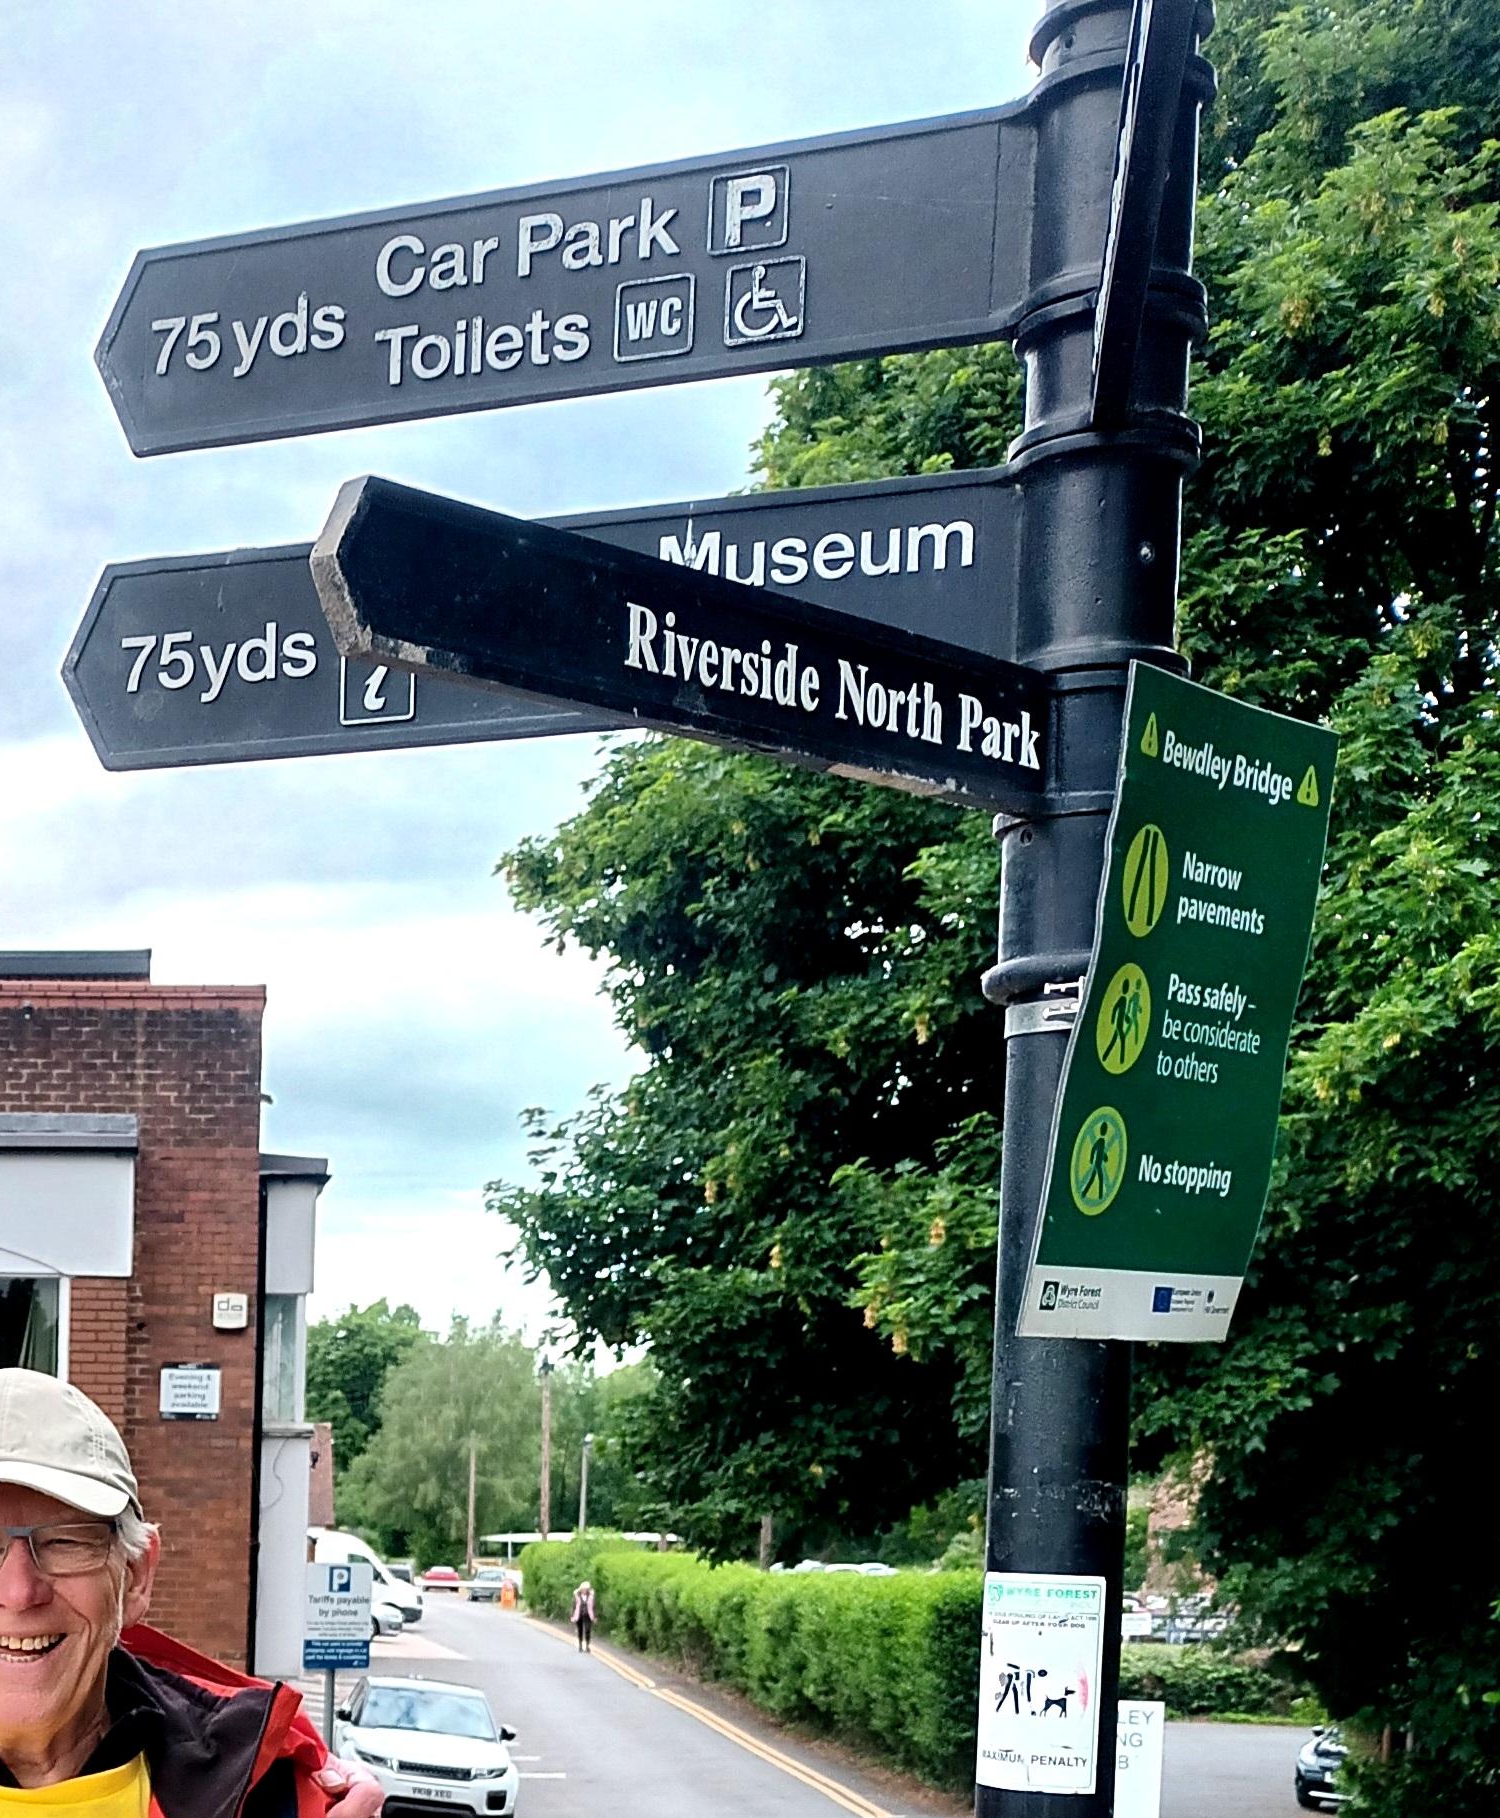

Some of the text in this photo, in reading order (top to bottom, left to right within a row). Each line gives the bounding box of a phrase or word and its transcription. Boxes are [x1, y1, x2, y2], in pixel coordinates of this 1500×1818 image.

[376, 174, 778, 299] Car Park P
[151, 293, 345, 377] 75 yds
[374, 296, 684, 386] Toilets WC
[658, 518, 975, 587] Museum
[121, 634, 194, 693] 75
[199, 622, 317, 704] yds
[625, 602, 1042, 771] Riverside North Park
[1162, 730, 1293, 806] Bewdley Bridge
[1182, 851, 1243, 892] Narrow
[1176, 895, 1266, 935] pavements
[1167, 972, 1202, 1006] Pass
[1202, 982, 1248, 1021] safely
[1162, 1009, 1260, 1055] be considerate
[1156, 1049, 1219, 1084] to others
[1138, 1154, 1233, 1198] No stopping
[1047, 1588, 1098, 1600] FOREST
[1031, 1755, 1088, 1767] PENALTY
